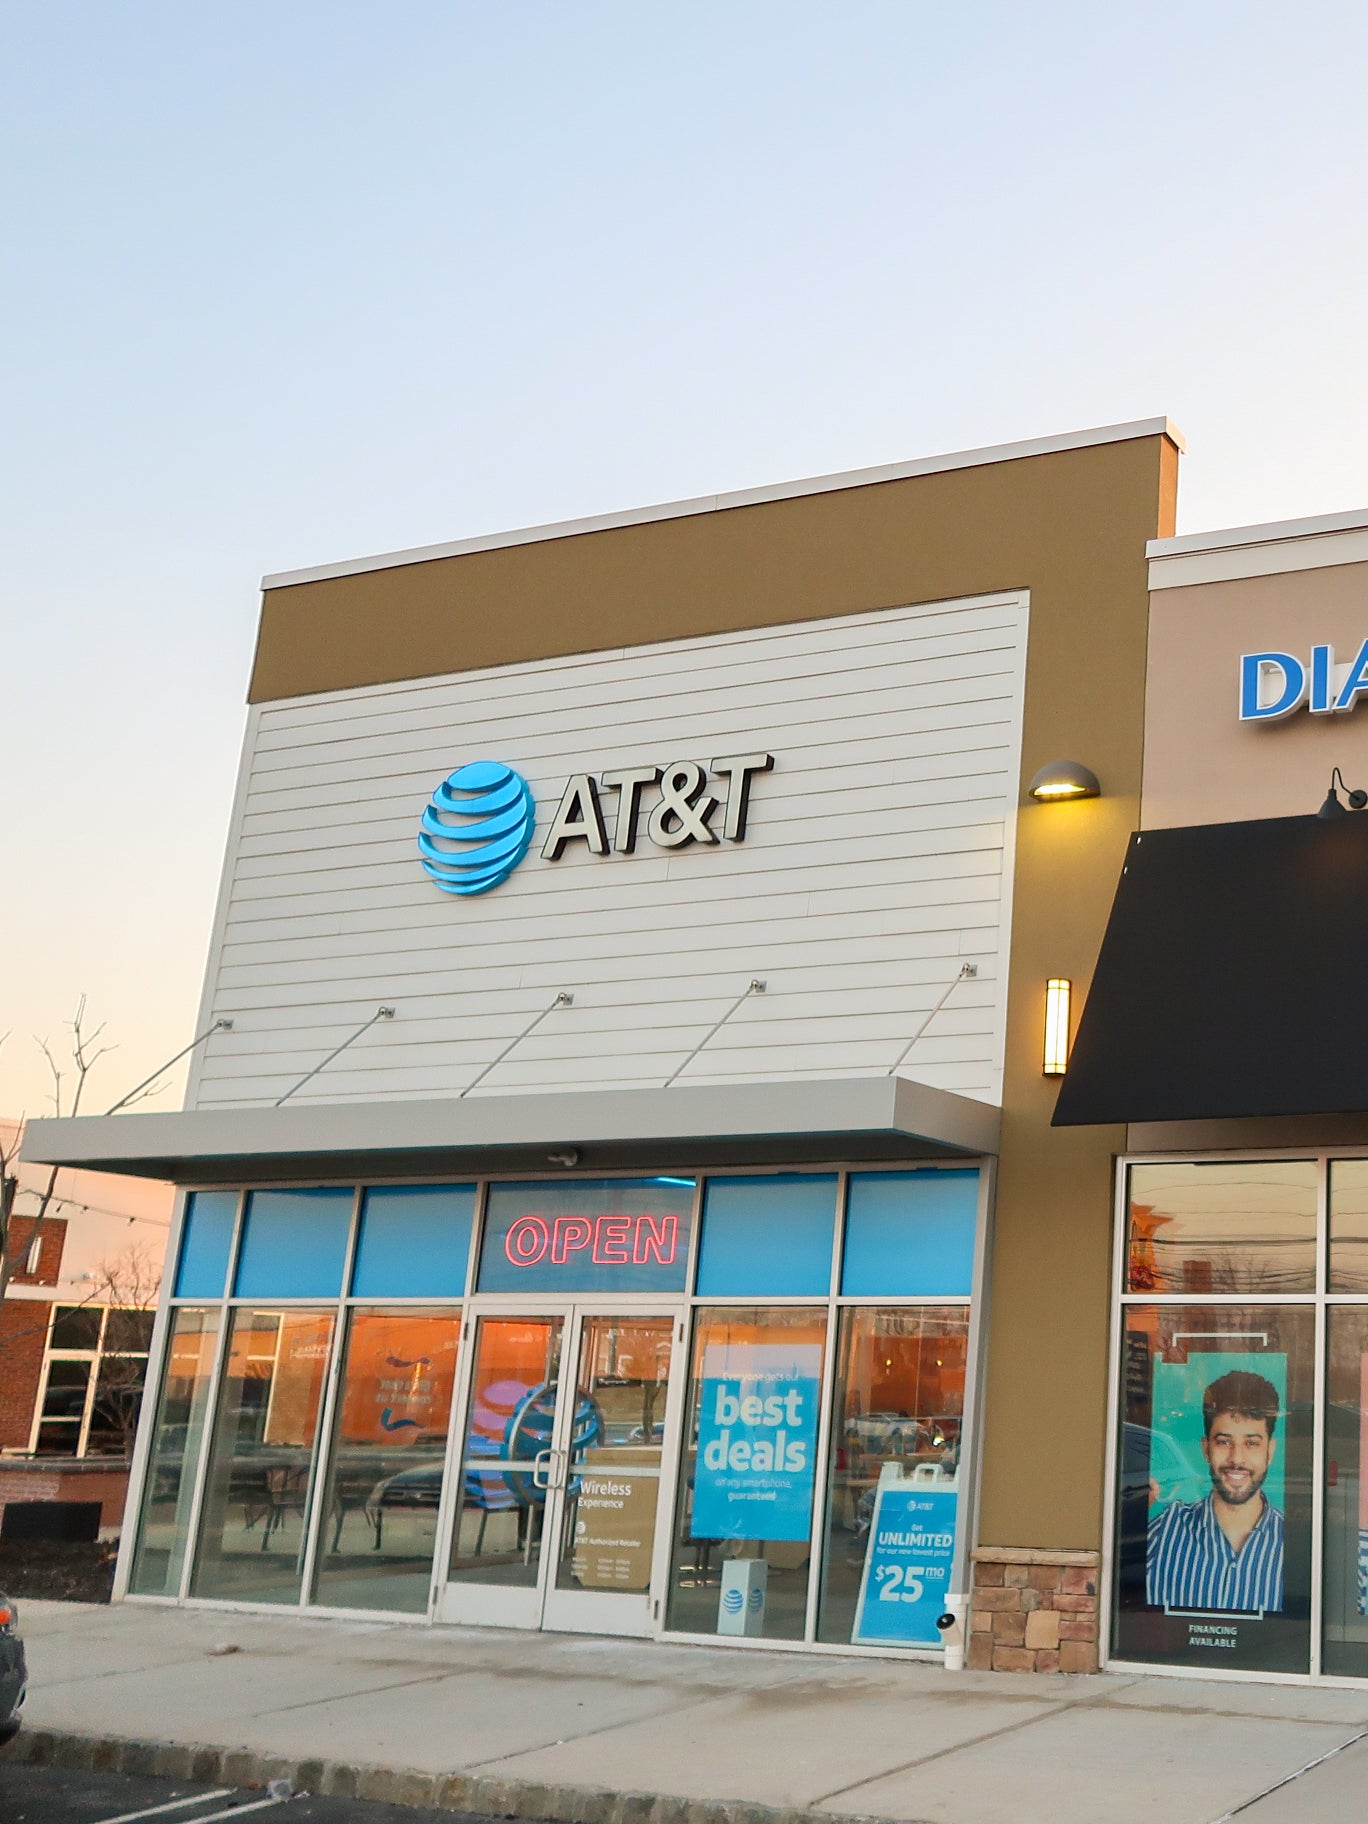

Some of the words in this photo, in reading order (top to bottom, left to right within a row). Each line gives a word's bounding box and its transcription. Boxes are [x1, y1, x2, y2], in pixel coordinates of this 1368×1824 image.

[540, 753, 775, 861] AT&T
[505, 1215, 679, 1267] OPEN
[714, 1384, 803, 1427] best
[703, 1429, 806, 1472] deals
[580, 1481, 632, 1496] Wireless
[879, 1532, 953, 1547] UNLIMITED
[875, 1564, 925, 1603] $25
[925, 1567, 945, 1577] mo
[1188, 1624, 1238, 1636] FINANCING
[1188, 1637, 1237, 1648] AVAILABLE
